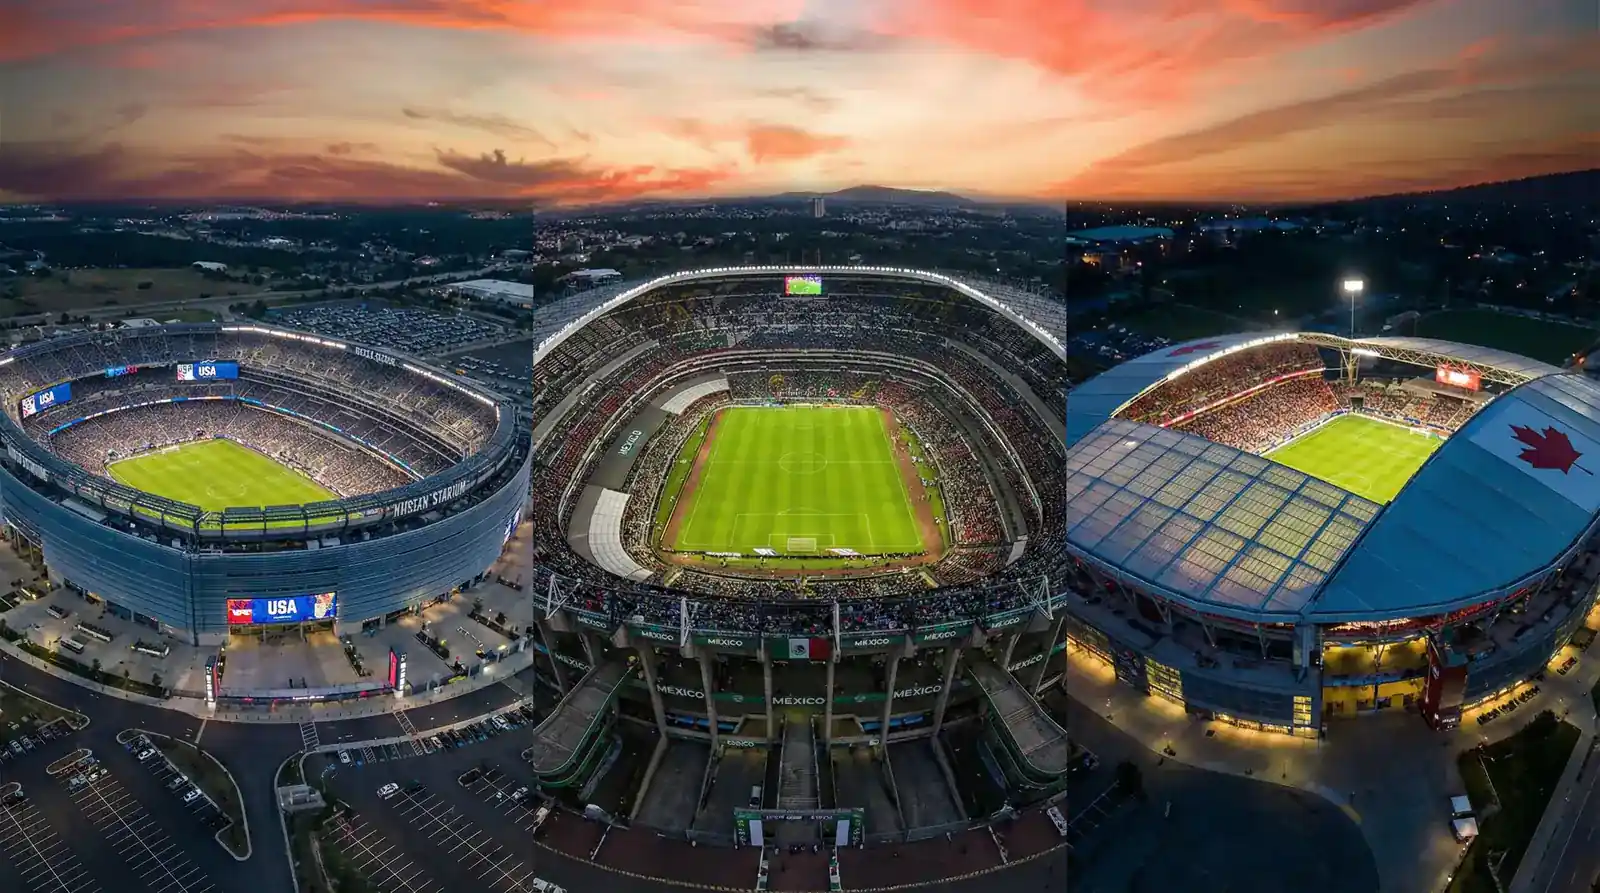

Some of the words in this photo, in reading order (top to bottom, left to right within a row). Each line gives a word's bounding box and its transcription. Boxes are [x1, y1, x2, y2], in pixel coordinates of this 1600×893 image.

[198, 365, 216, 377] USA
[40, 390, 55, 405] USA
[618, 430, 642, 455] MEXICO
[267, 599, 298, 615] USA
[577, 615, 607, 629] MEXICO
[641, 630, 674, 642] MEXICO
[707, 638, 743, 647] MEXICO
[854, 638, 890, 647] MEXICO
[924, 630, 957, 641] MEXICO
[555, 652, 592, 672] MEXICO
[1007, 654, 1043, 672] MEXICO
[656, 684, 705, 699] MEXICO
[893, 684, 942, 699] MEXICO
[772, 696, 826, 705] MEXICO
